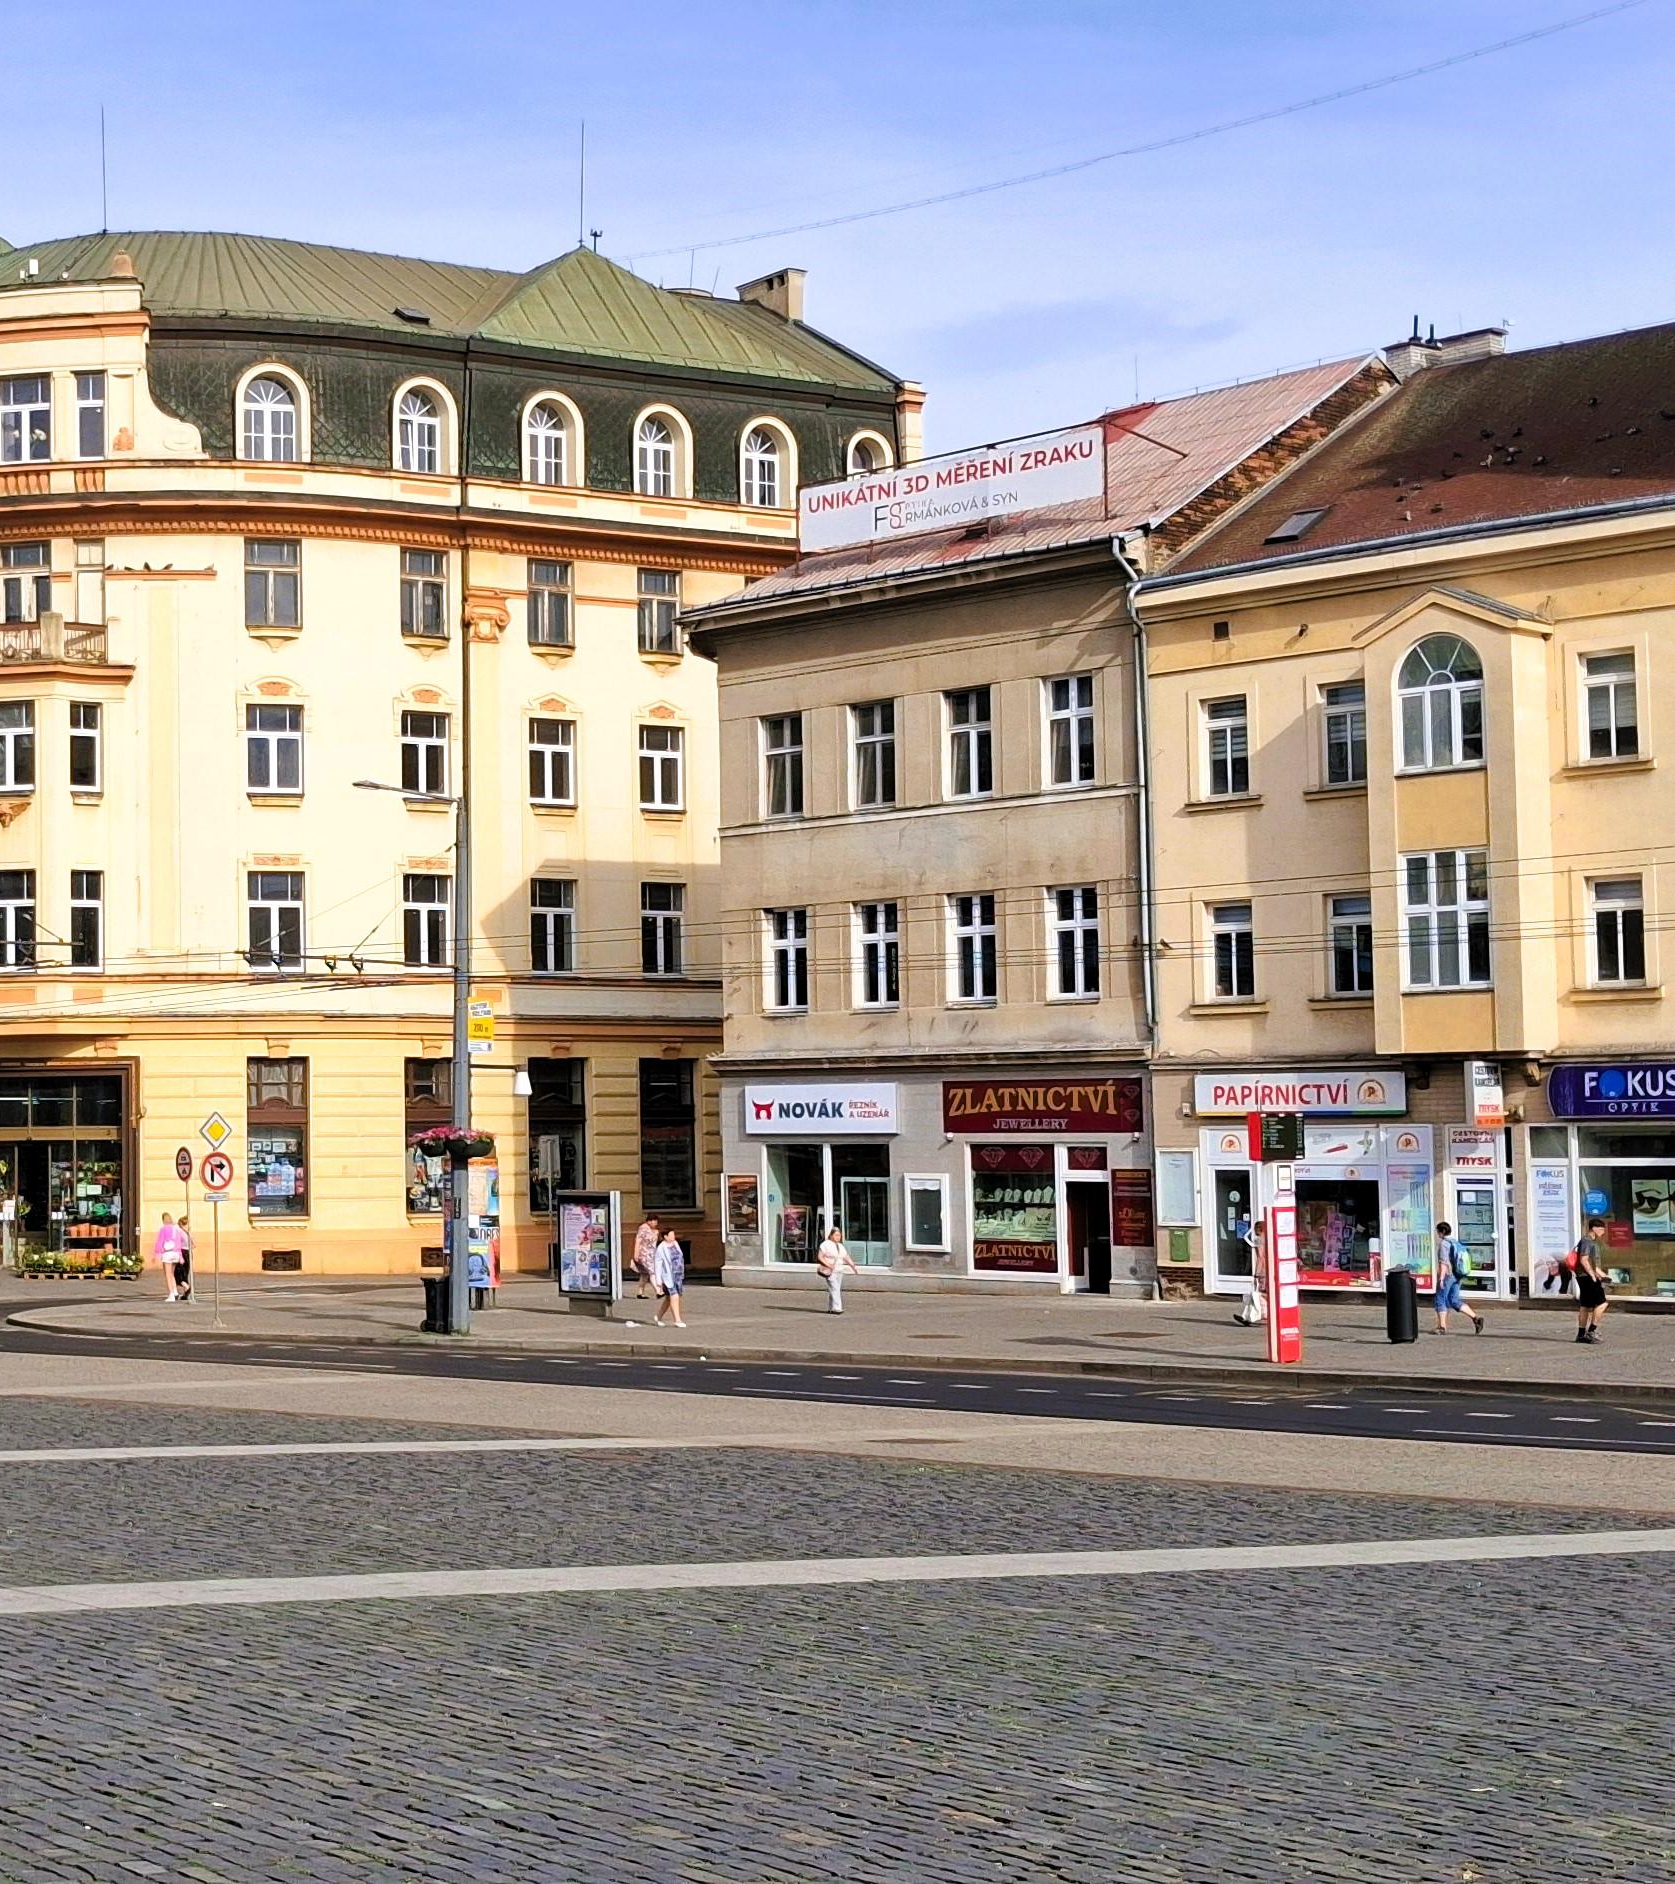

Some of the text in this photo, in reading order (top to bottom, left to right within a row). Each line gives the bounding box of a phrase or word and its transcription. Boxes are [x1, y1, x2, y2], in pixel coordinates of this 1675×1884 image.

[808, 440, 1093, 513] UNIKÁTNÍ 3D MĚŘENÍ ZRAKU
[981, 496, 989, 508] &
[992, 491, 1018, 507] SYN
[948, 1079, 1118, 1117] ZLATNICTVÍ
[1214, 1078, 1349, 1105] PAPÍRNICTVÍ
[778, 1098, 844, 1118] NOVÁK
[1608, 1102, 1659, 1112] OPTIK
[993, 1118, 1070, 1130] JEWELLERY
[974, 1242, 1056, 1261] ZLATNICTVÍ
